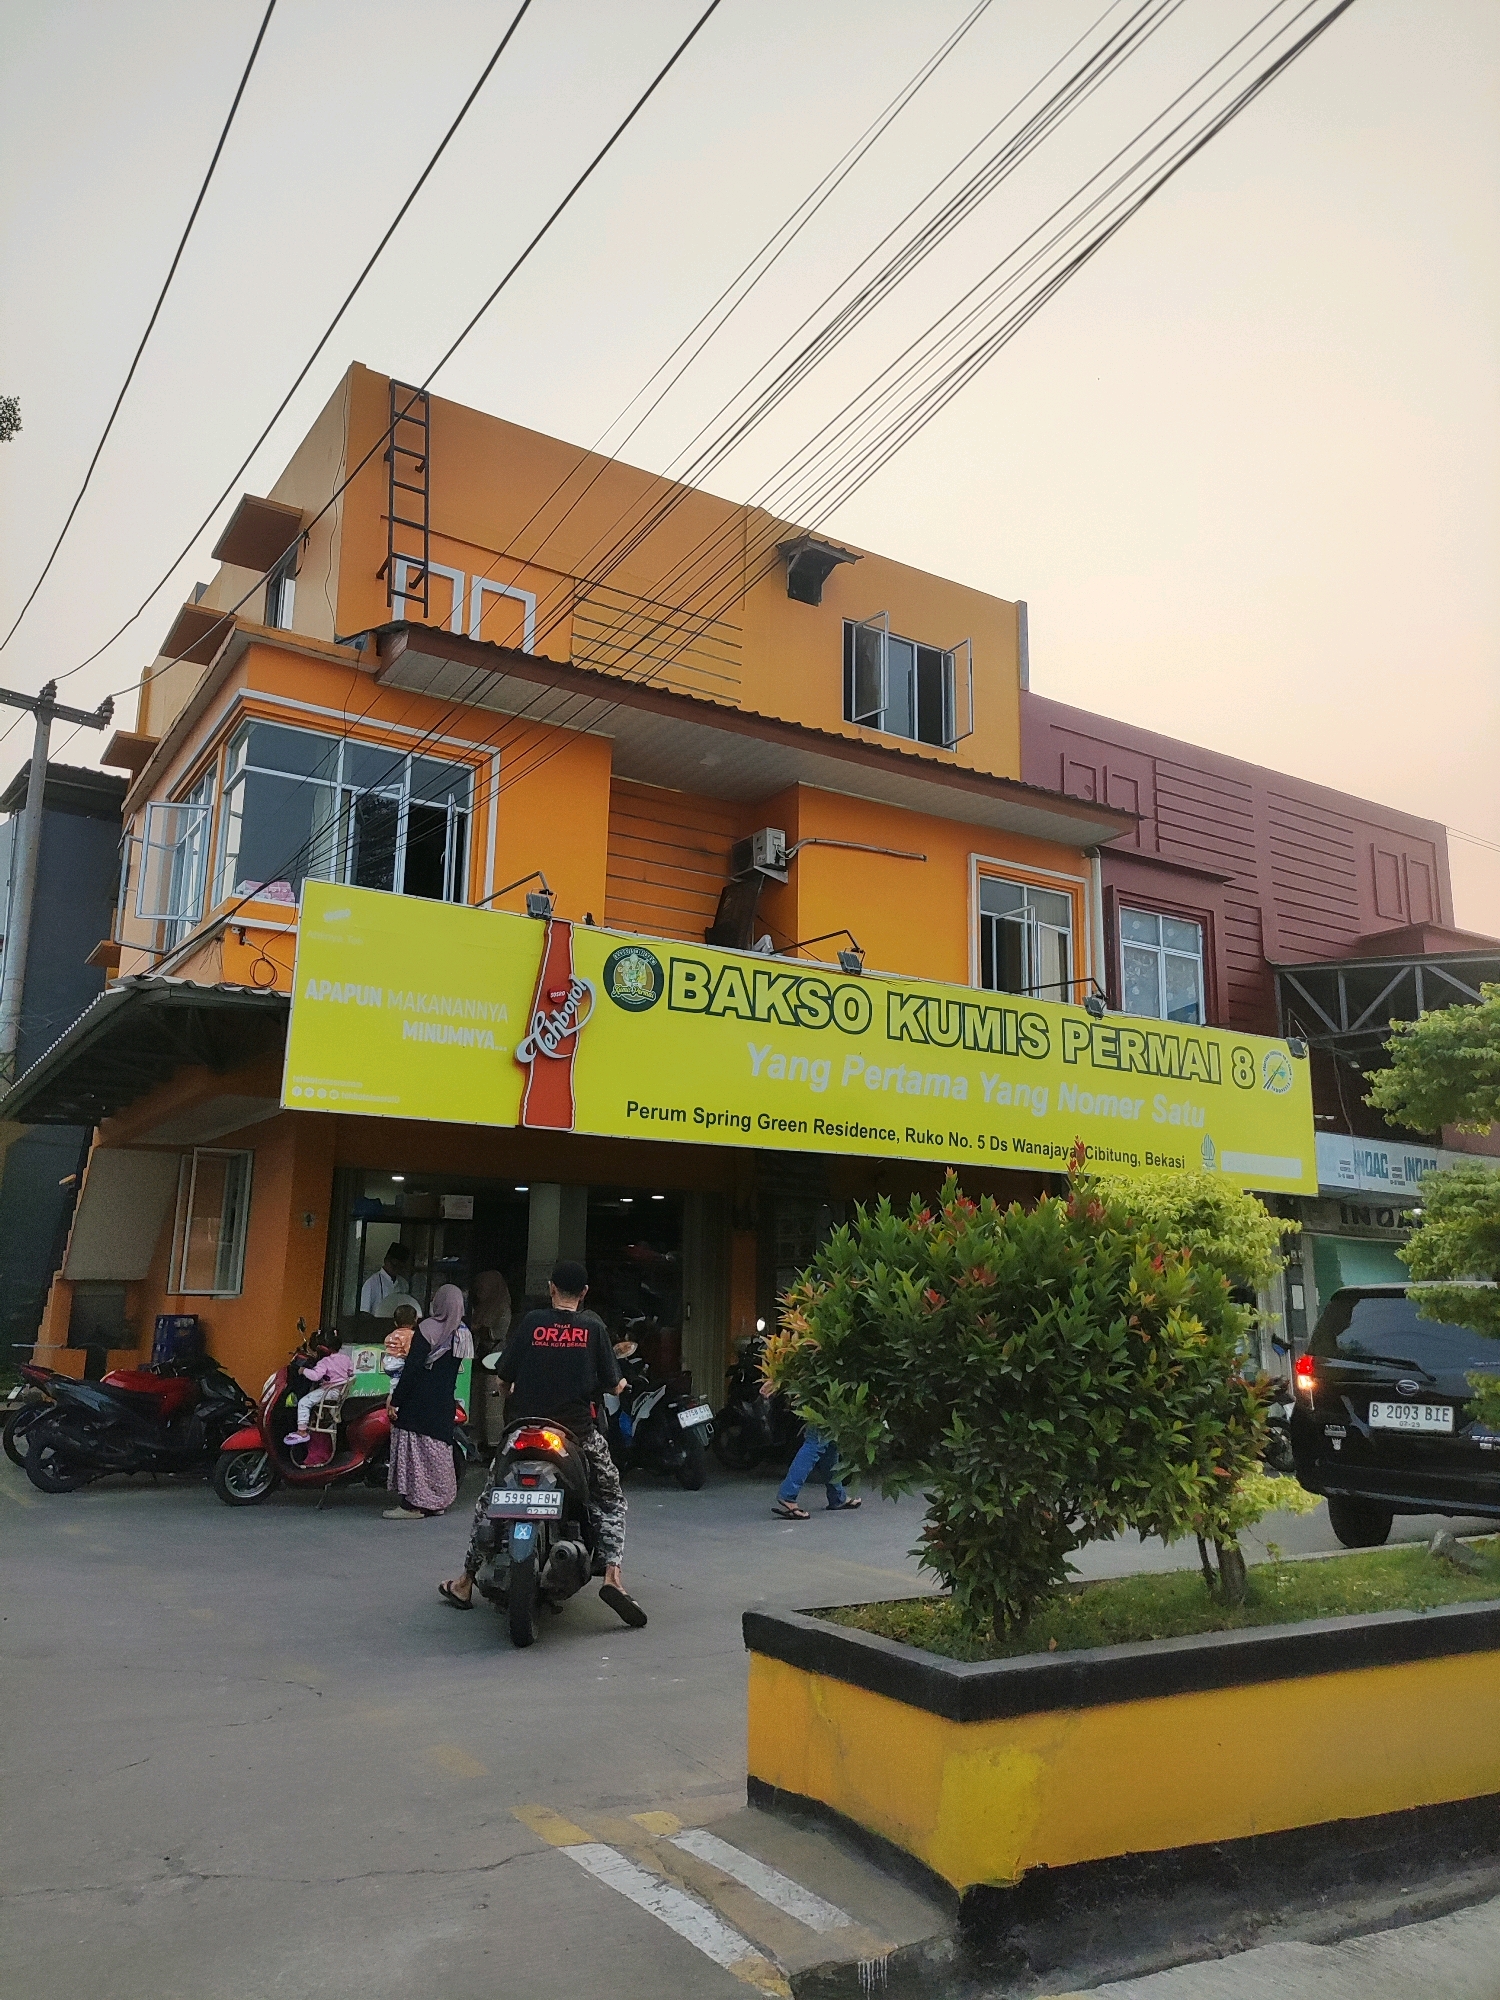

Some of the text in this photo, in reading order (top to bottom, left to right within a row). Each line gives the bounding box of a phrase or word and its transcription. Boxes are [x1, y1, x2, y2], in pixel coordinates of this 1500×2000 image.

[304, 978, 509, 1024] APAPUN MAKANANNYA
[667, 956, 873, 1035] BAKSO
[887, 990, 1051, 1060] KUMIS
[1062, 1017, 1222, 1086] PERMAI
[1231, 1045, 1256, 1090] 8
[747, 1042, 1206, 1128] Yang Pertama Yang Nomer Satu
[626, 1101, 687, 1122] Perum
[693, 1107, 752, 1132] Spring
[757, 1113, 808, 1134] Green
[813, 1118, 901, 1144] Residence,
[905, 1127, 944, 1146] Ruko
[948, 1131, 973, 1148] No.
[977, 1135, 986, 1150] 5
[989, 1136, 1008, 1152] Ds
[1085, 1145, 1141, 1168] Cibitung,
[1145, 1151, 1185, 1169] Bekasi
[533, 1326, 588, 1342] ORARI
[1372, 1403, 1450, 1422] B 2093 BIE
[493, 1492, 500, 1504] B
[505, 1492, 533, 1504] 5998
